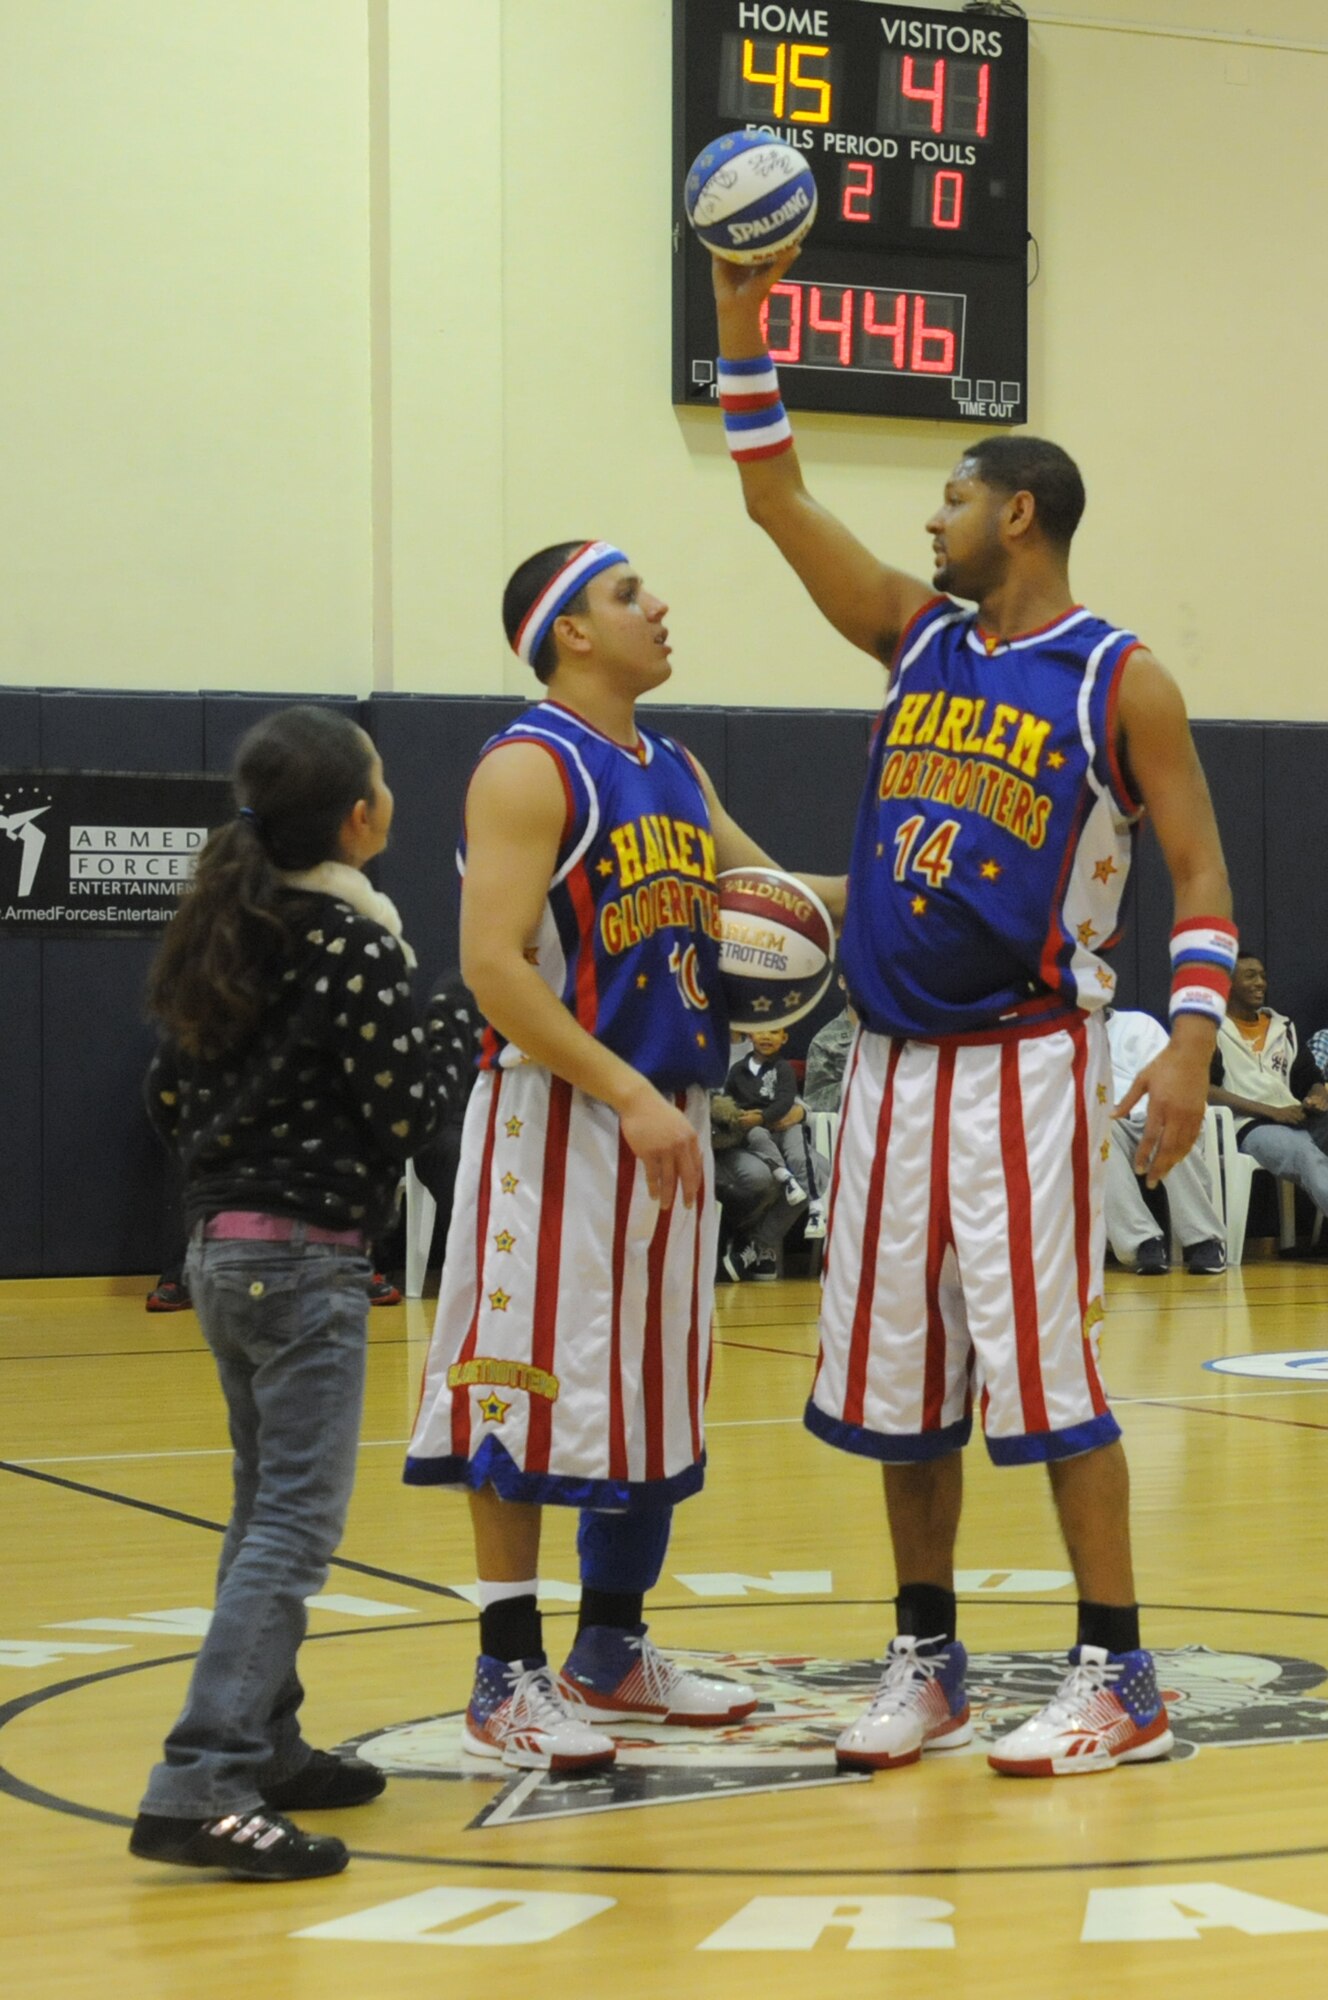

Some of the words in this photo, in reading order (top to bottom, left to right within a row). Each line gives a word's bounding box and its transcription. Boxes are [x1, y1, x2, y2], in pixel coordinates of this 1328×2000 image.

[738, 2, 828, 37] HOME
[880, 17, 1002, 58] VISITORS
[741, 38, 831, 124] 45
[901, 55, 989, 138] 41
[823, 132, 898, 158] PERIOD
[910, 140, 976, 165] FOULS
[727, 186, 810, 245] SPALDING
[842, 162, 874, 222] 2
[932, 170, 963, 229] 0
[958, 401, 986, 416] TIME
[989, 403, 1014, 418] OUT
[885, 690, 1052, 778] HARLEM
[77, 830, 201, 848] ARMED
[893, 814, 962, 888] 14
[69, 881, 197, 896] ENTERTAINMEN
